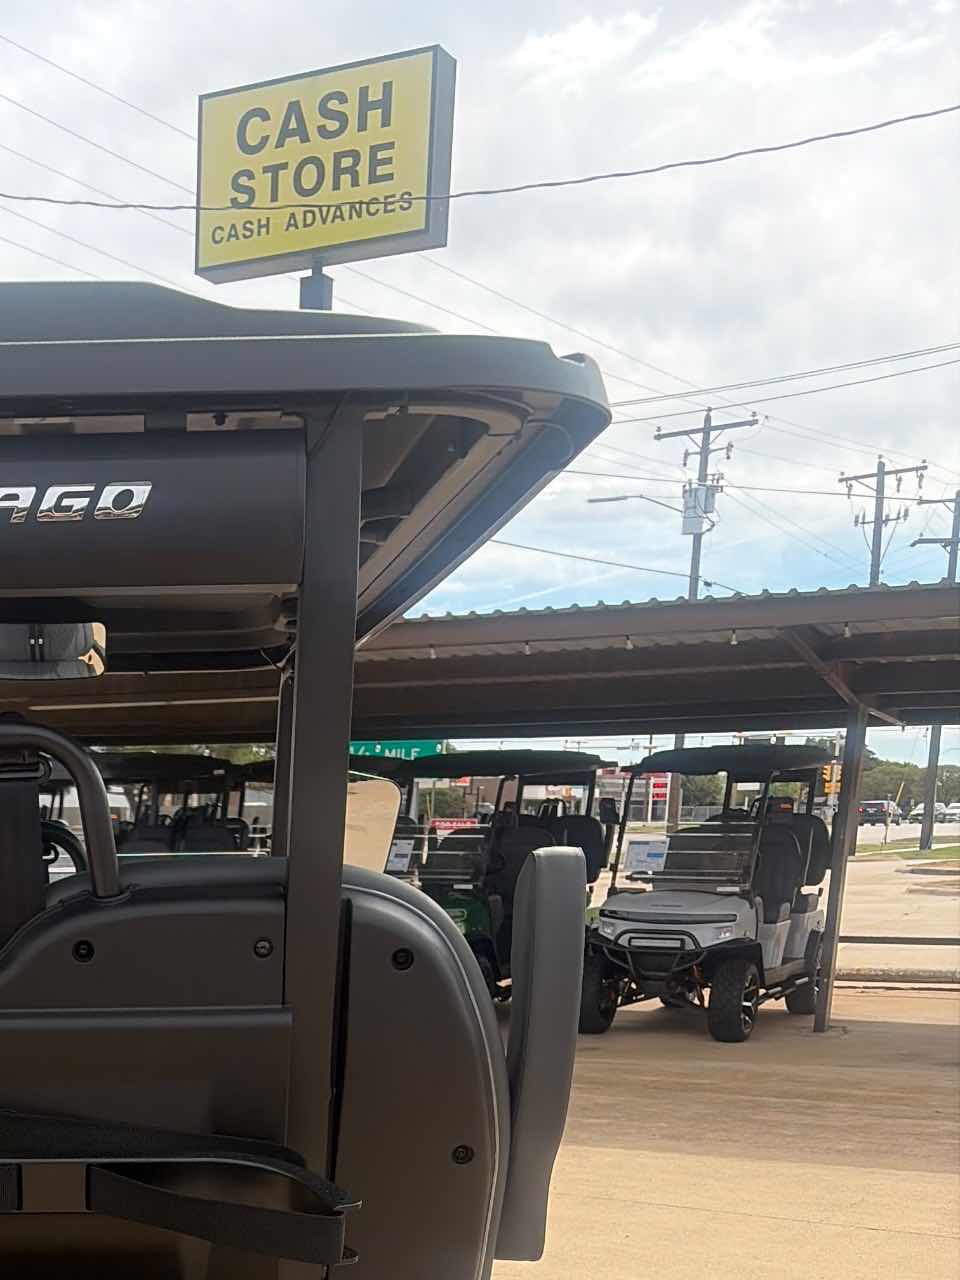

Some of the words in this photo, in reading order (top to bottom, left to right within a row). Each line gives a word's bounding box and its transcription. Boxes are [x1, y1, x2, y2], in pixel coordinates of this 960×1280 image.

[236, 80, 393, 155] CASH
[230, 141, 395, 209] STORE
[211, 216, 270, 244] CASH
[284, 191, 413, 232] ADVANCES
